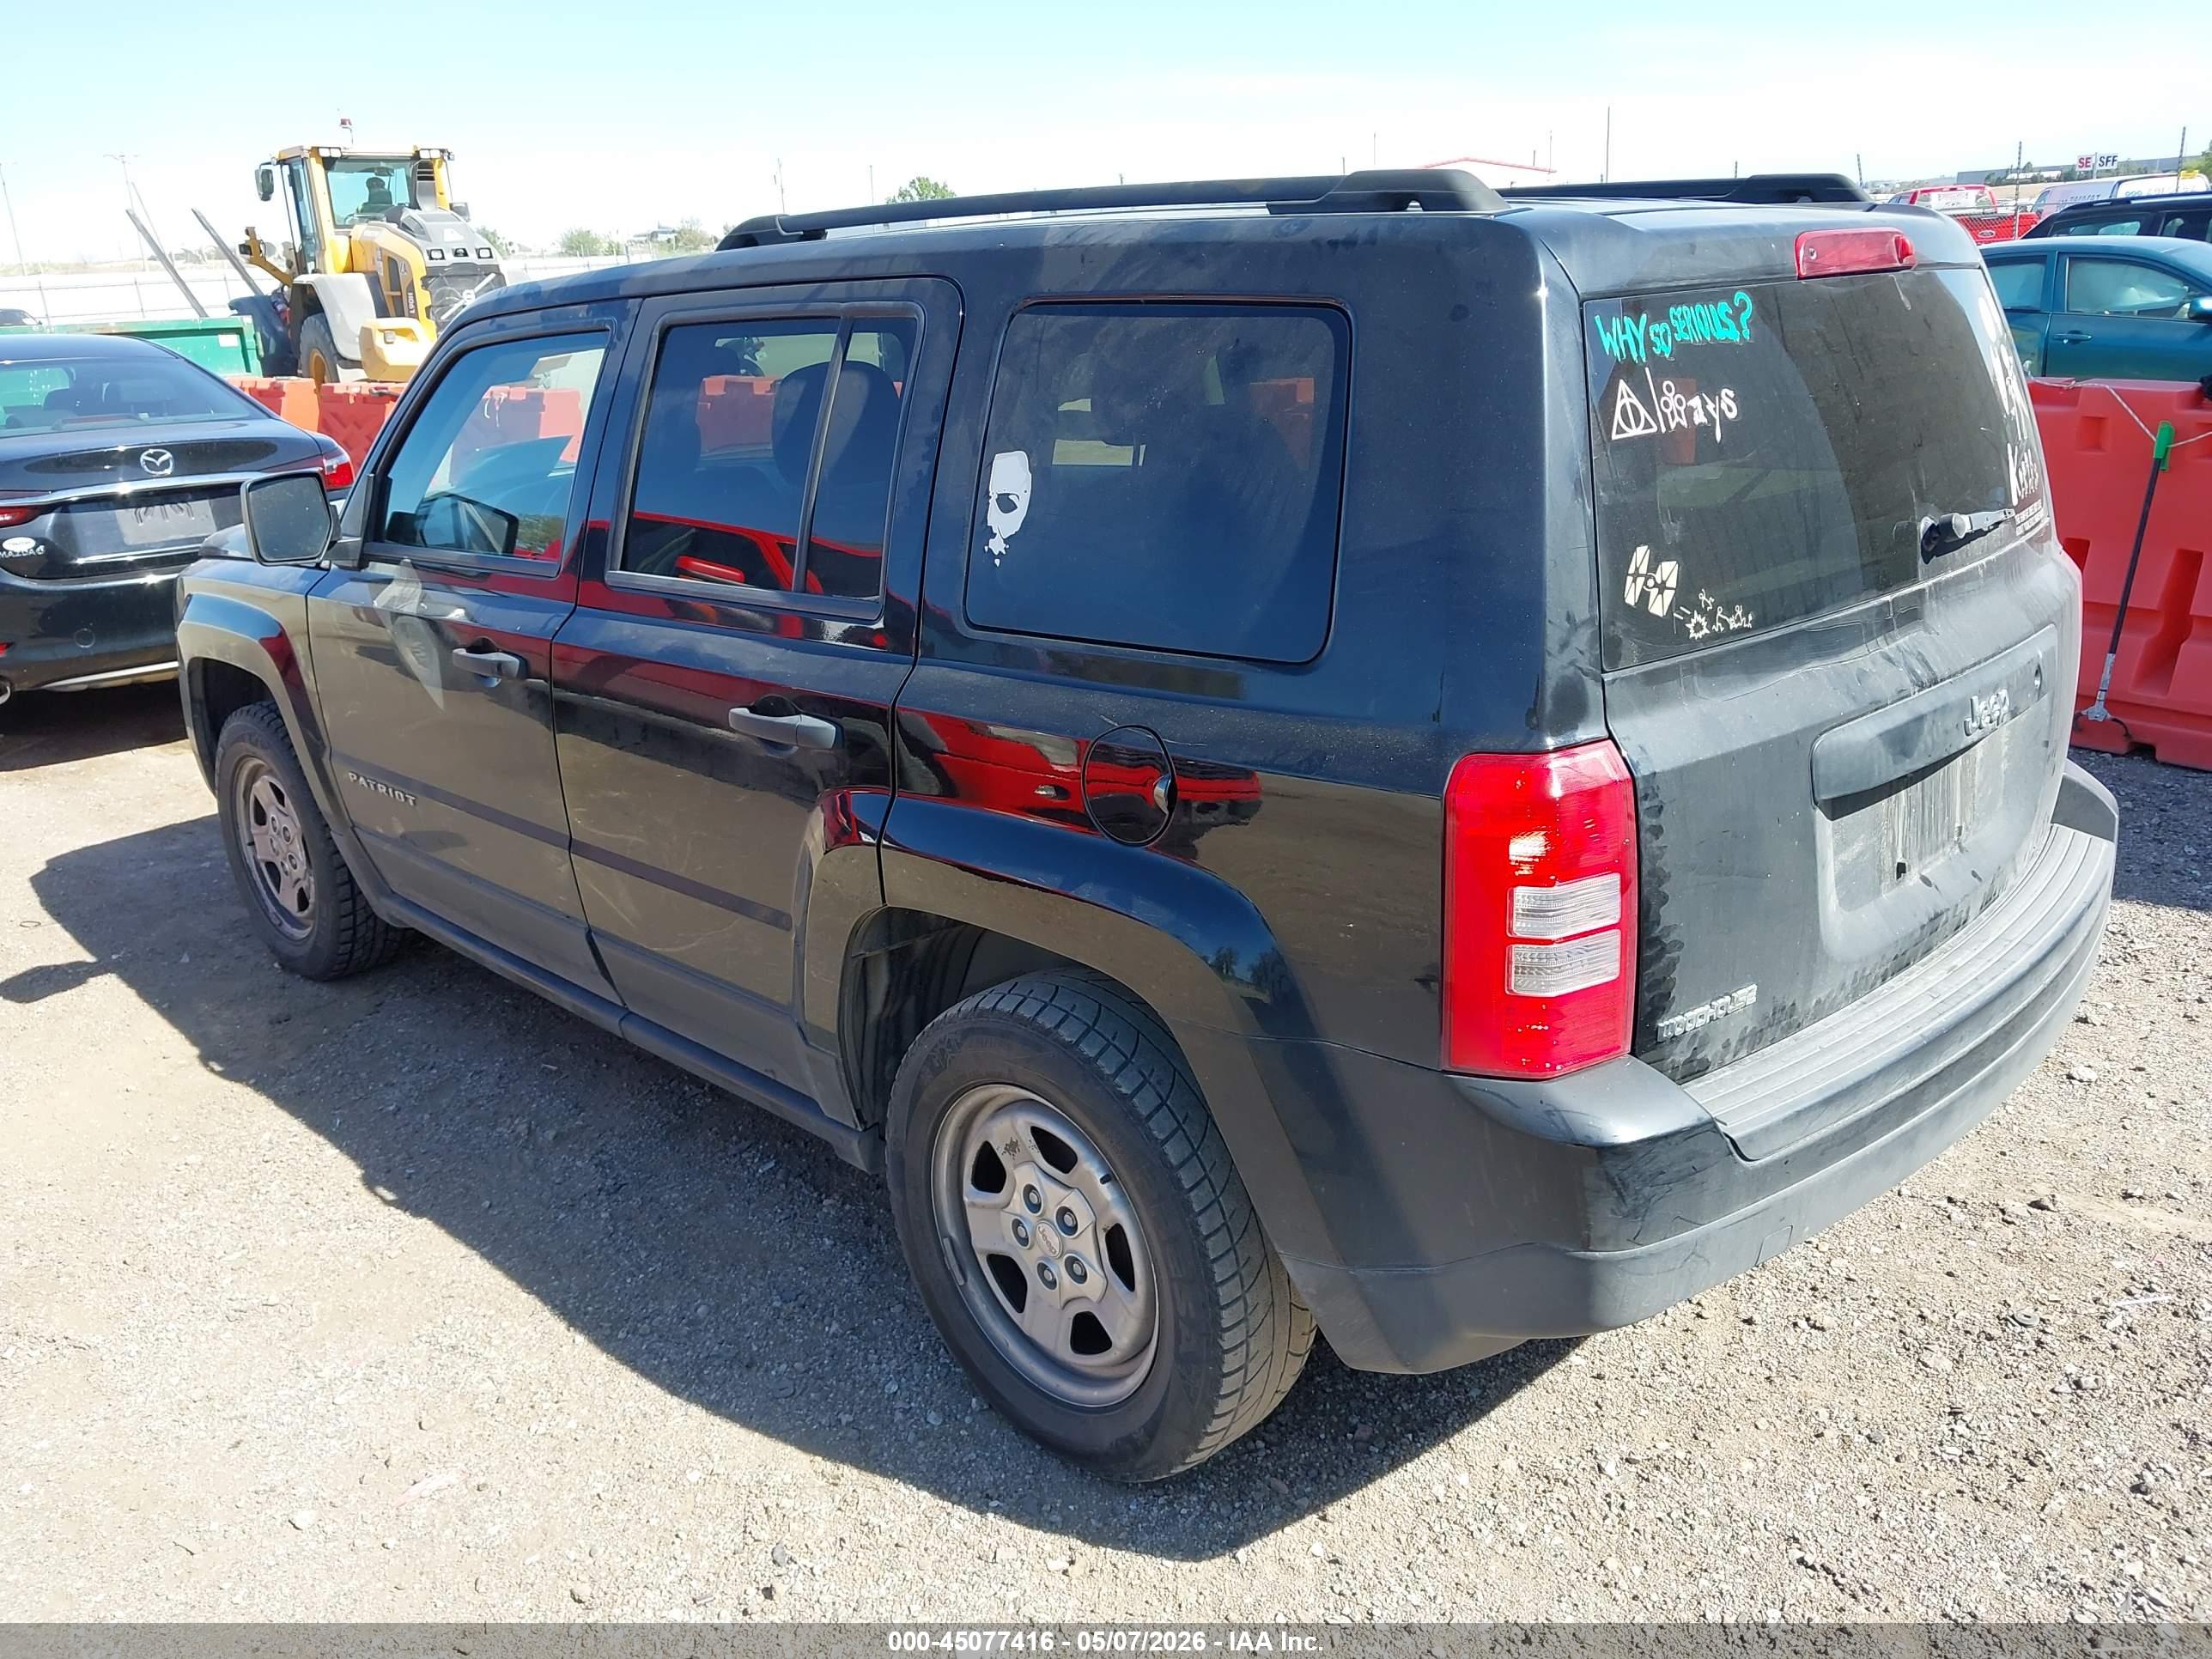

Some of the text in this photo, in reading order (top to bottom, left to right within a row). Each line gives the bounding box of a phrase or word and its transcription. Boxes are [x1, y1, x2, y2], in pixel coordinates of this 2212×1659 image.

[2078, 156, 2092, 168] SE
[1595, 291, 1753, 363] WHY SO SERIOUS?
[1964, 689, 2010, 736] Jeep
[348, 771, 416, 806] PATRIOT
[1037, 1225, 1057, 1255] Jeep
